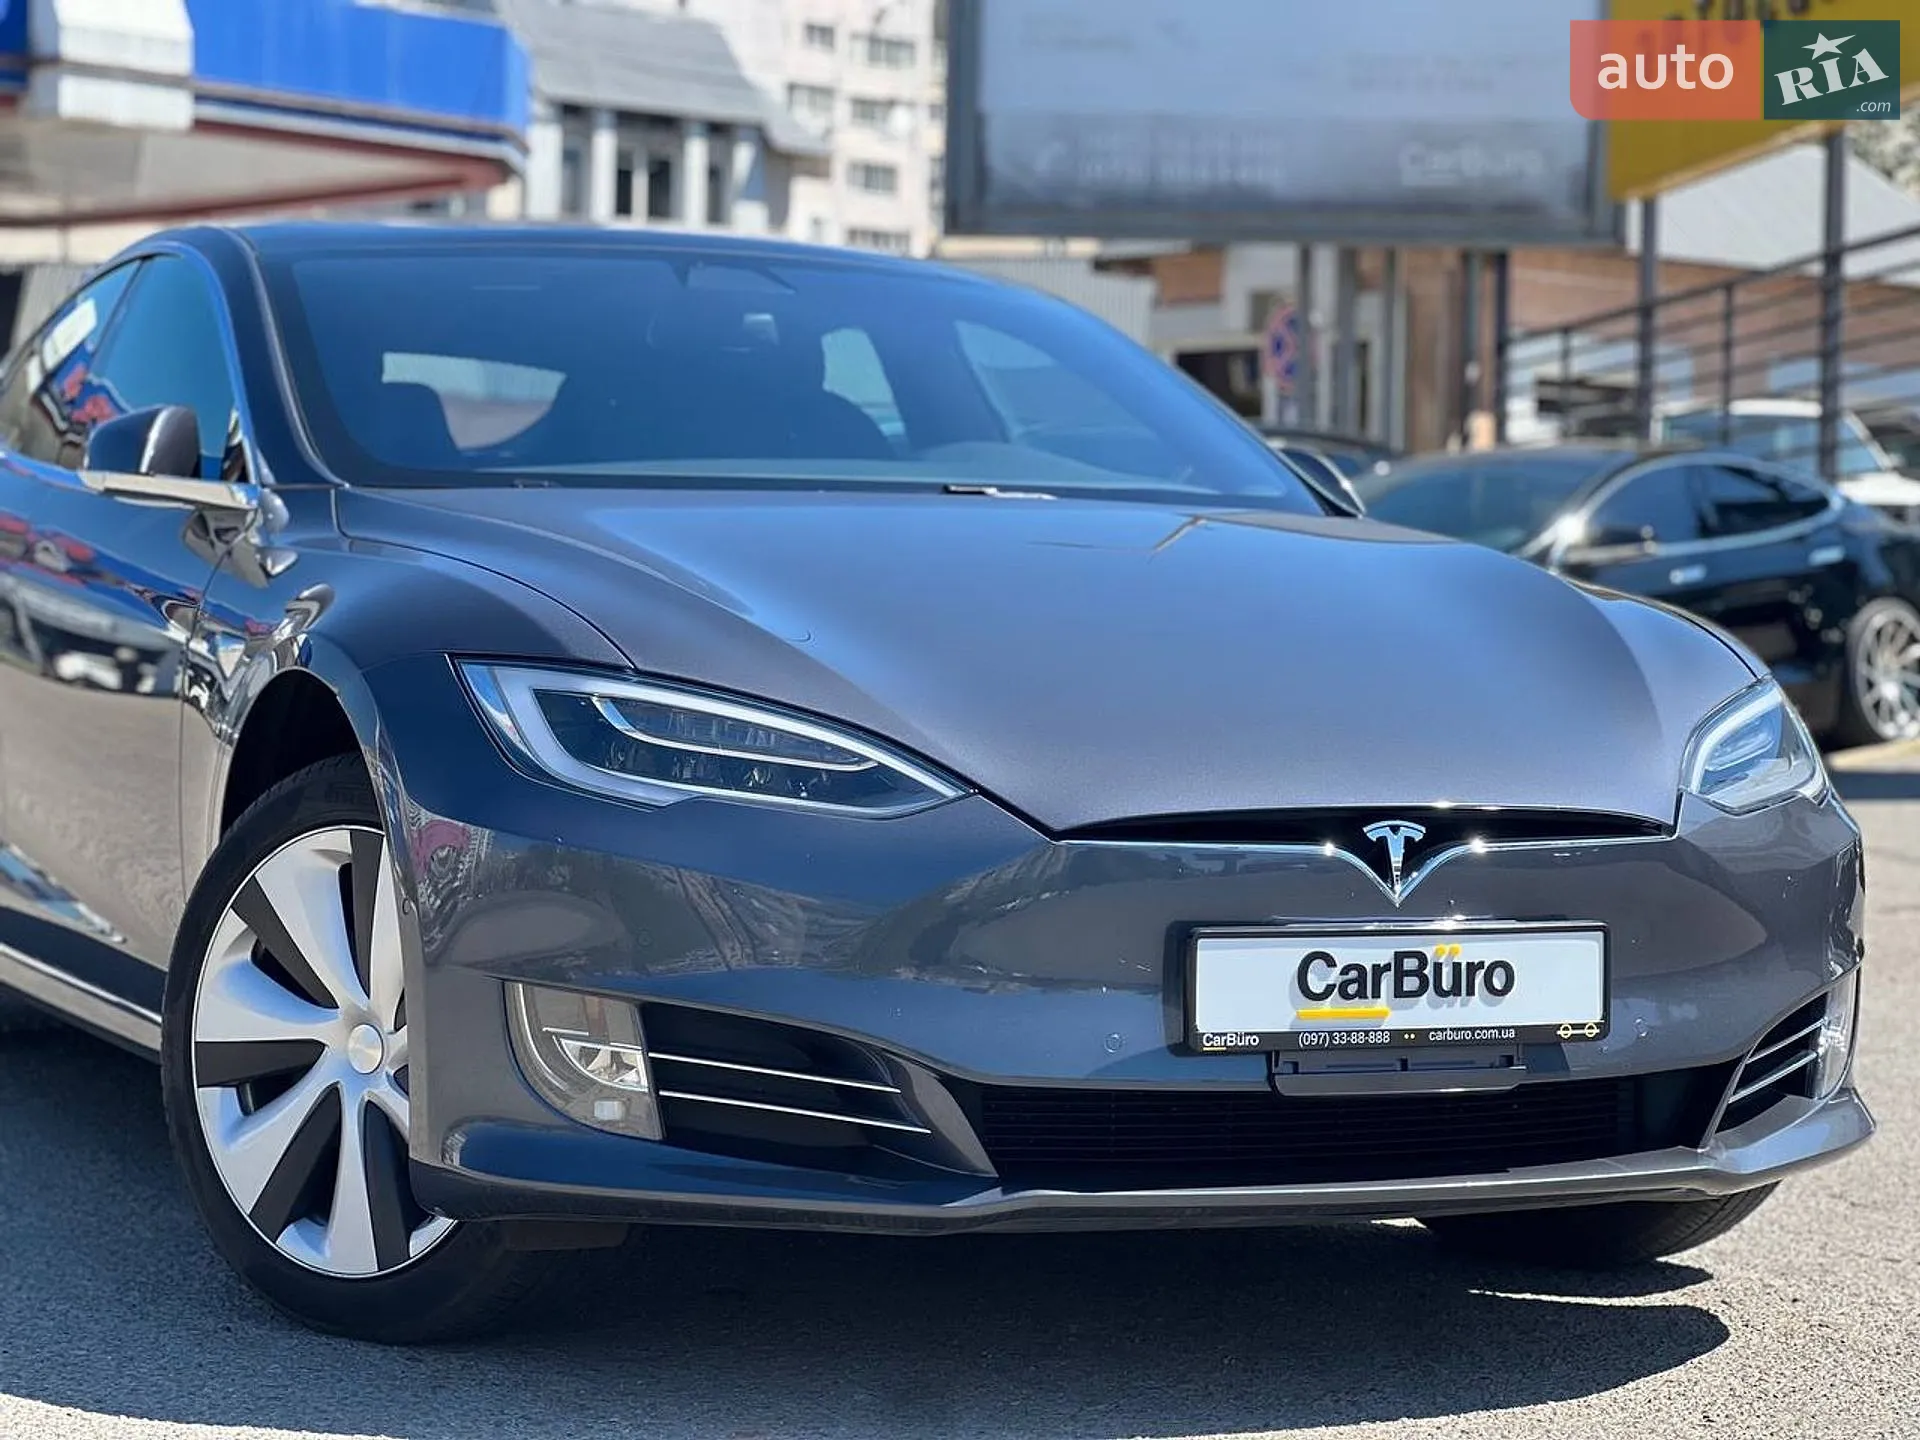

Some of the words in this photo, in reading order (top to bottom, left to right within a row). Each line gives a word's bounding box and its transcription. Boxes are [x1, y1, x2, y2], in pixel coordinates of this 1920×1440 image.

[1297, 945, 1515, 1002] CarBüro
[1202, 1032, 1259, 1047] CarBüro
[1298, 1032, 1330, 1048] (097)
[1332, 1031, 1390, 1045] 33-88-888
[1428, 1028, 1515, 1042] carburo.com.ua
